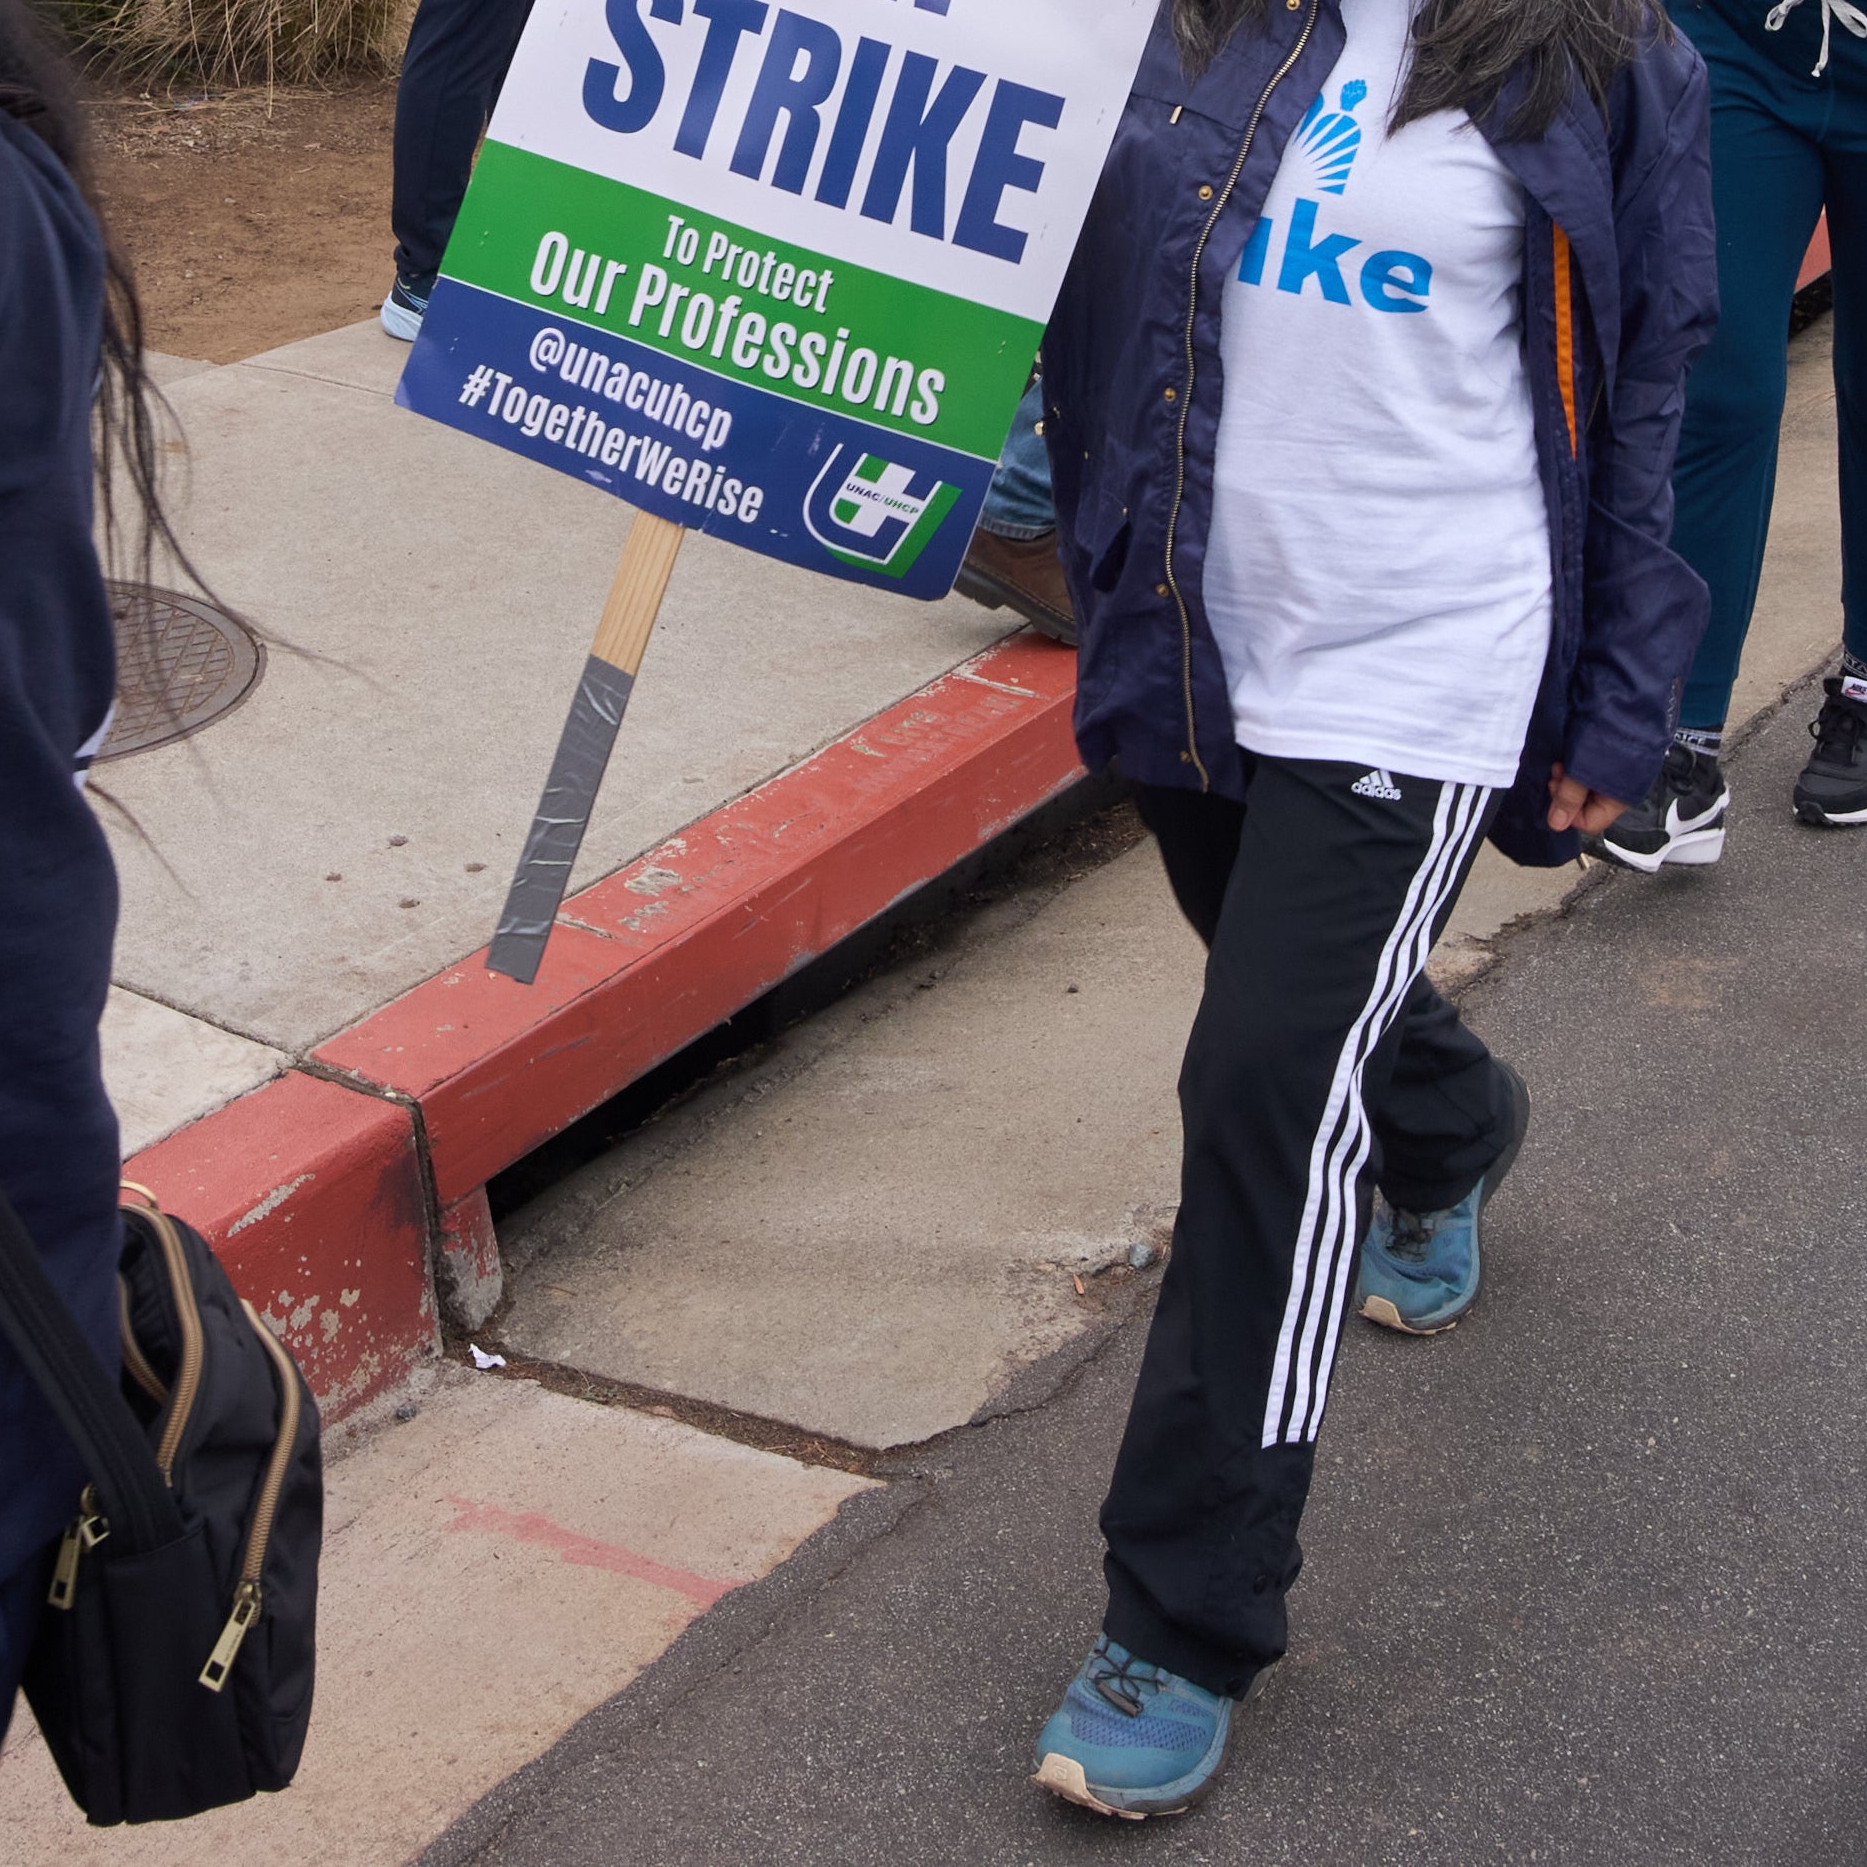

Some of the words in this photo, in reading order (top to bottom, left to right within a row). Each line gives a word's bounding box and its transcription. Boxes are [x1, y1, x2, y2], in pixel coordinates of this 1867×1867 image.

[662, 214, 699, 266] To
[703, 230, 835, 314] Protect
[530, 230, 627, 315] Our
[628, 263, 946, 425] Professions
[458, 364, 765, 524] #TogetherWeRise
[529, 327, 733, 452] @unacuhcp
[846, 483, 919, 514] UNAC/UHCP
[1351, 782, 1401, 801] adidas
